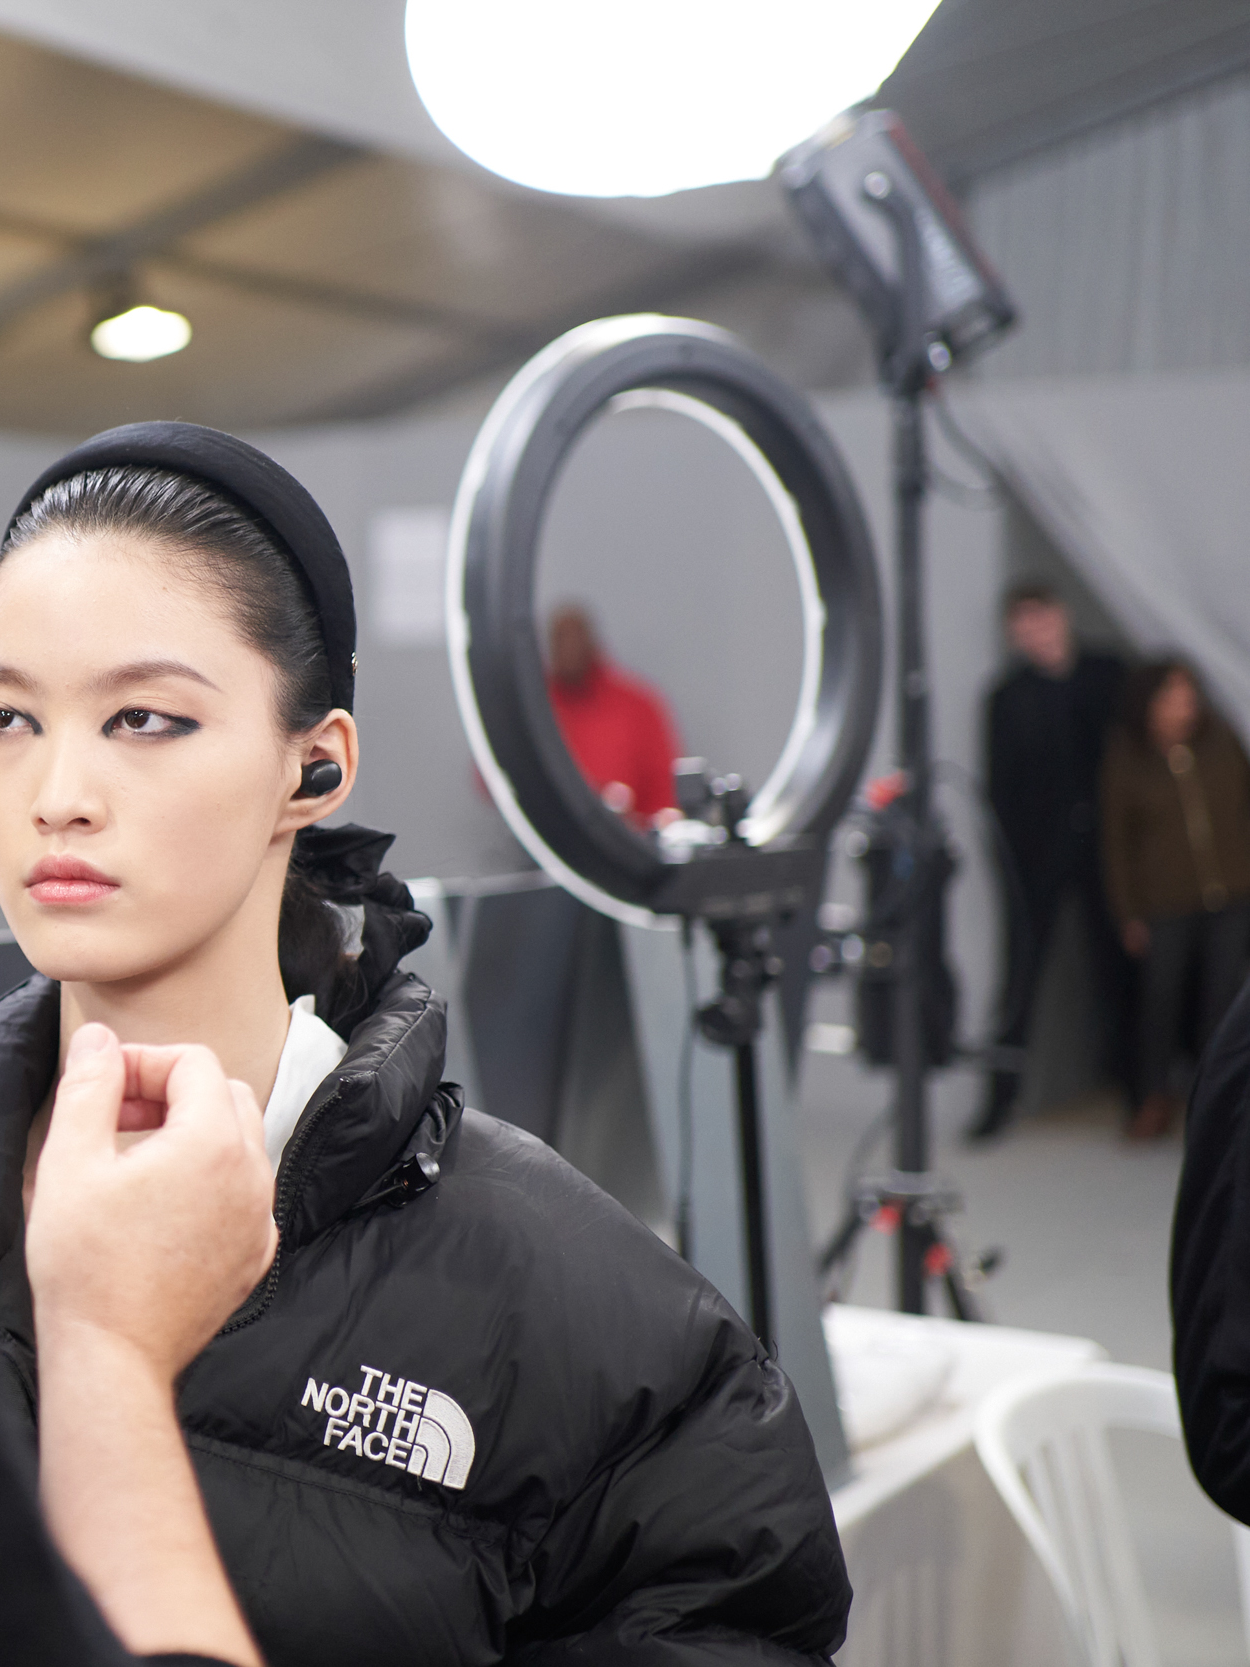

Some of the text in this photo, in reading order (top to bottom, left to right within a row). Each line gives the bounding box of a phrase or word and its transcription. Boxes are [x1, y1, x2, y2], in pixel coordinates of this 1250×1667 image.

[300, 1377, 421, 1443] NORTH
[360, 1364, 428, 1414] THE
[323, 1417, 413, 1470] FACE
